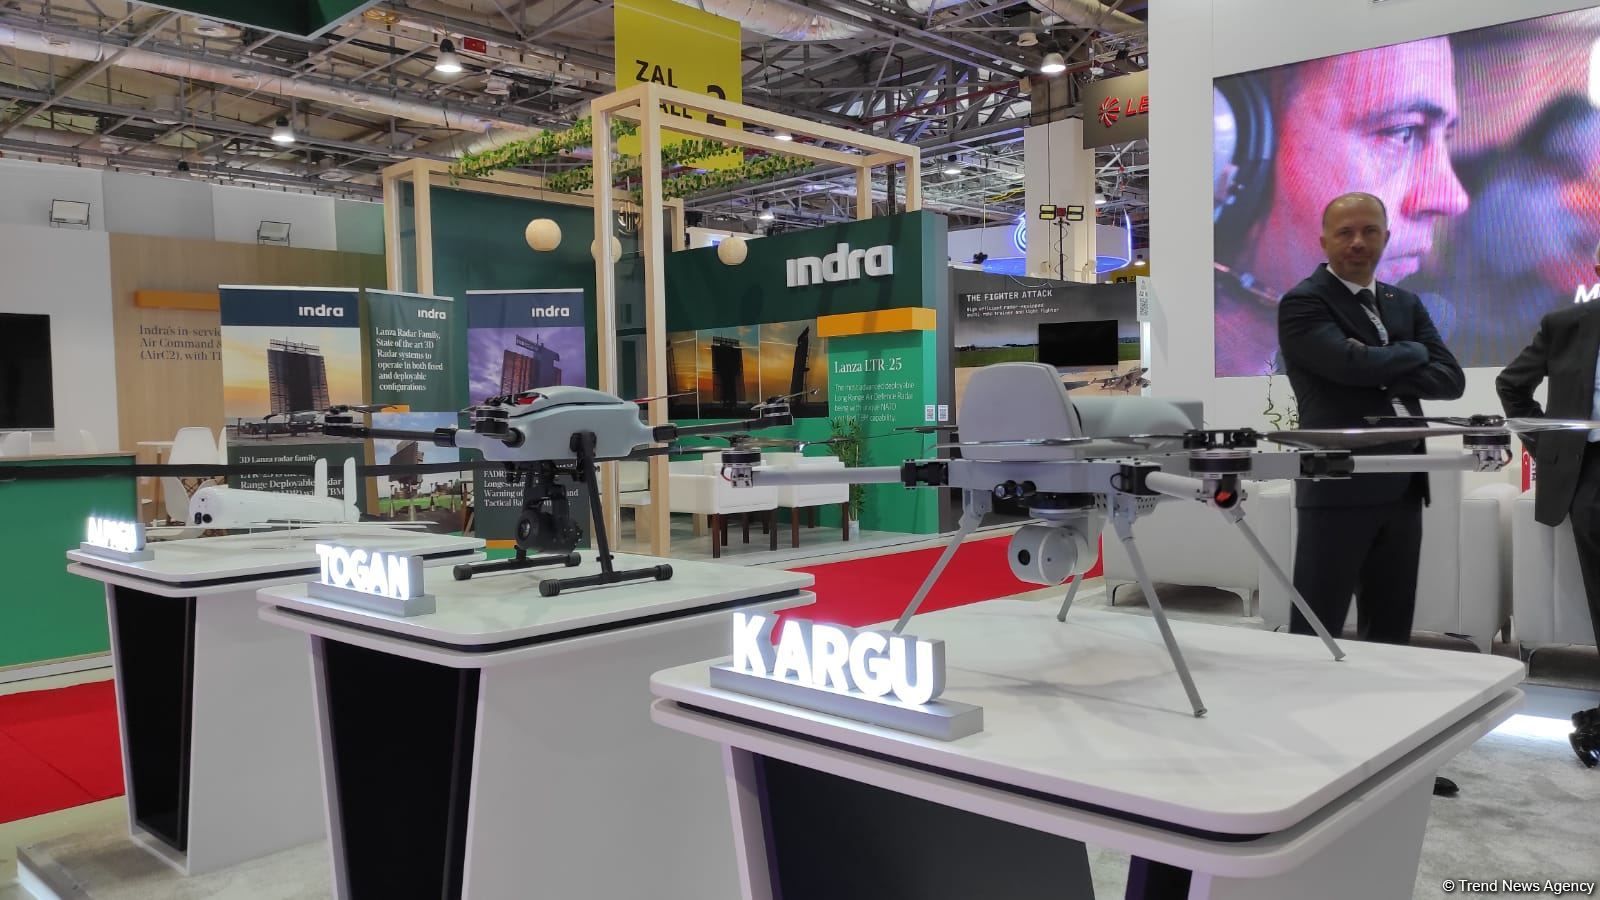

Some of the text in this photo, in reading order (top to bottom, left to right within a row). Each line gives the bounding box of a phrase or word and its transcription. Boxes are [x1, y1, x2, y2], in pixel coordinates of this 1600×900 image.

[636, 59, 678, 88] ZAL
[786, 242, 893, 287] indra
[966, 289, 1053, 302] THE FIGHTER ATTACK
[298, 304, 344, 317] indra
[417, 309, 446, 320] indra
[531, 305, 570, 317] indra
[139, 325, 176, 335] Indra's
[376, 326, 397, 336] Lanza
[397, 328, 417, 338] Radar
[140, 338, 157, 348] Air
[159, 338, 214, 349] Command
[376, 338, 394, 347] State
[395, 339, 402, 348] of
[402, 339, 413, 348] the
[424, 340, 434, 349] 3D
[185, 351, 207, 360] with
[377, 349, 397, 358] Radar
[398, 351, 424, 360] systems
[377, 361, 403, 370] operate
[412, 361, 427, 370] both
[834, 357, 902, 374] Lanza LTR-25
[378, 371, 427, 382] and deployable
[379, 382, 427, 392] configurations
[885, 380, 914, 390] deployable
[834, 394, 847, 402] Long
[848, 394, 864, 402] Range
[874, 392, 896, 401] Defence
[897, 391, 914, 400] Radar
[880, 402, 897, 411] NATO
[295, 454, 317, 463] family
[240, 477, 342, 490] Range Deployable dar
[483, 489, 516, 498] Warning
[483, 498, 511, 507] Tactical
[315, 543, 412, 600] TOGAN
[733, 611, 942, 705] KARGU
